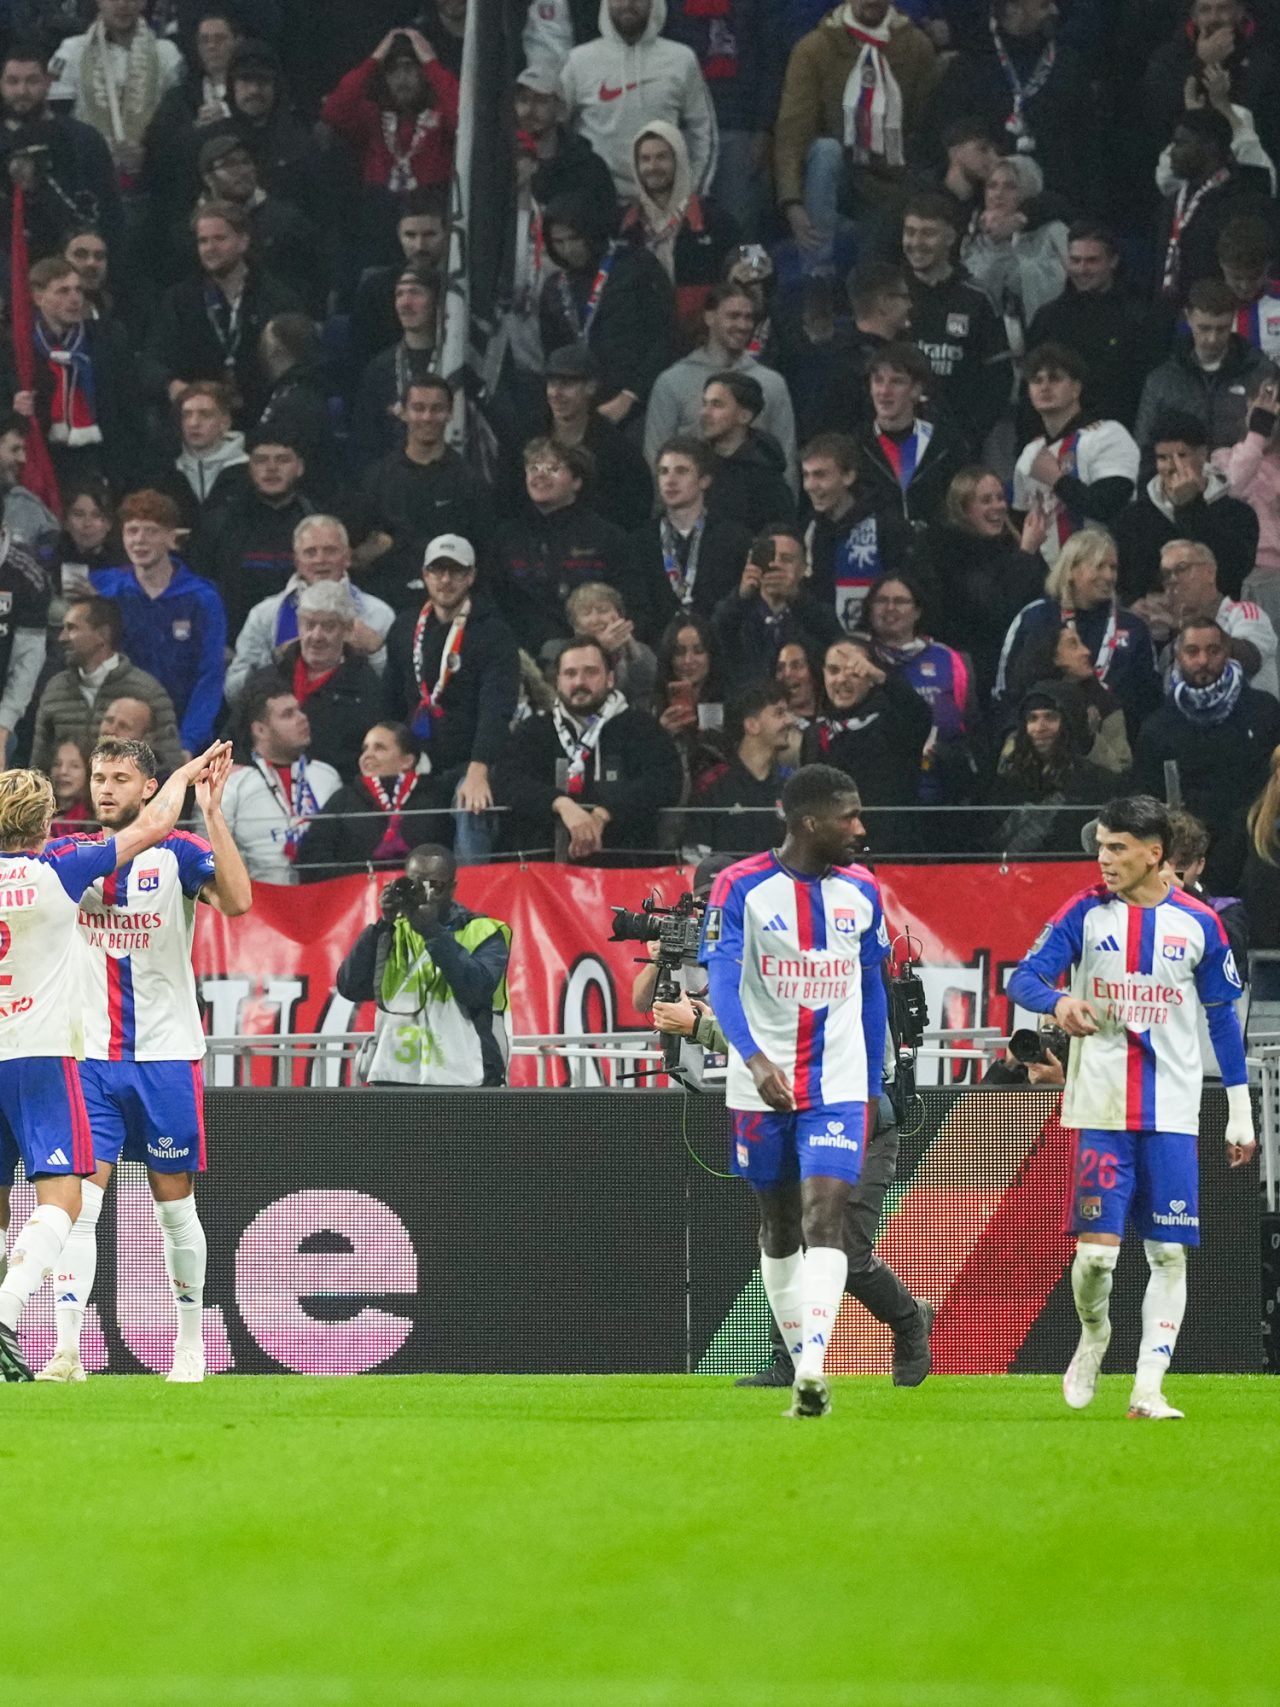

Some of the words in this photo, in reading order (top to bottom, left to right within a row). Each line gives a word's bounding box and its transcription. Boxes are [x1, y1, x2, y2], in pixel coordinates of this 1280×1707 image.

[140, 878, 157, 889] OL
[836, 919, 854, 931] OL
[108, 932, 150, 949] BETTER
[1163, 945, 1183, 958] OL
[761, 954, 856, 978] Emirates
[777, 981, 797, 998] FLY
[803, 981, 848, 999] BETTER
[1093, 977, 1183, 1006] Emirates
[1127, 1006, 1168, 1024] BETTER
[147, 1143, 190, 1159] trainline
[809, 1132, 858, 1152] trainline
[1080, 1147, 1118, 1189] 26
